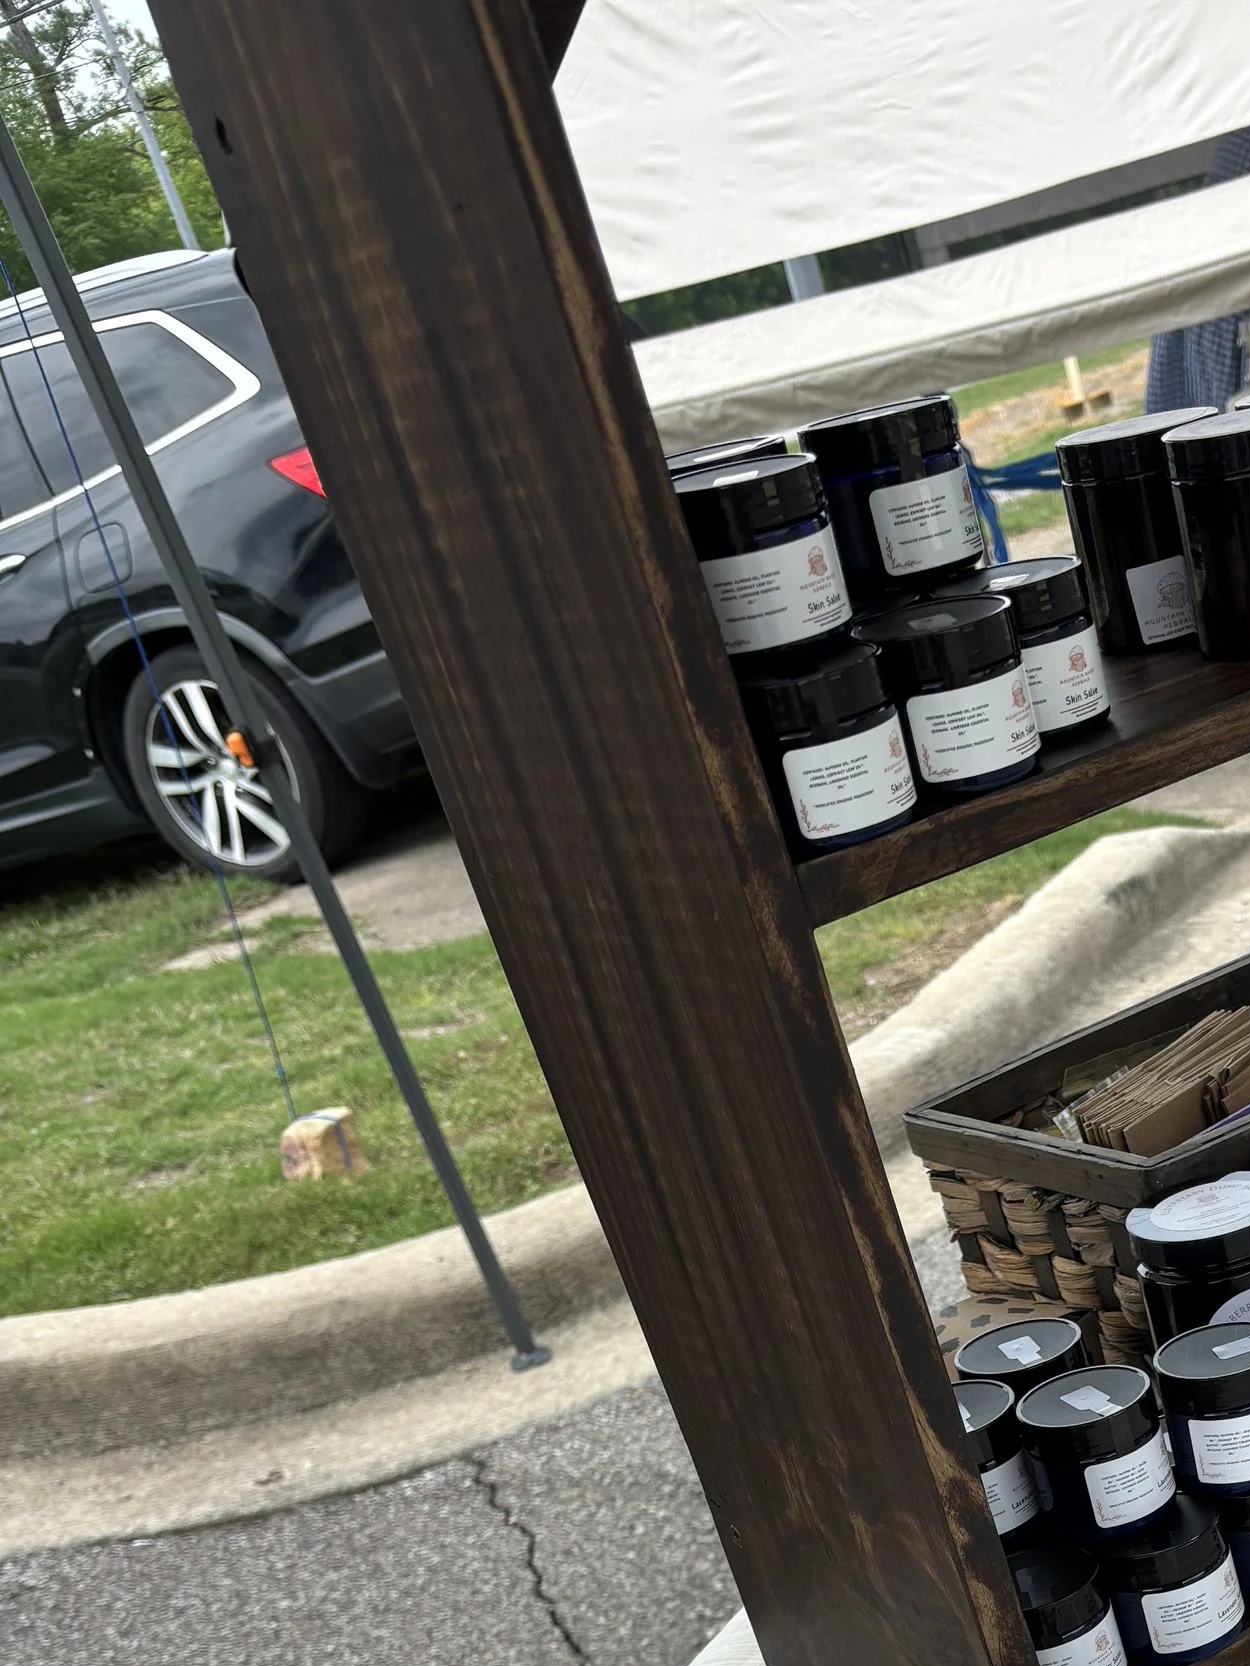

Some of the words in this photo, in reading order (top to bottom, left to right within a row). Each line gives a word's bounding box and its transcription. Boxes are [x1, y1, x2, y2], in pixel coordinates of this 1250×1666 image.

[808, 599, 825, 614] Skin
[826, 593, 841, 608] Salve
[1066, 694, 1082, 706] Skin
[1084, 687, 1099, 700] Salve
[1011, 729, 1024, 742] Skin
[891, 782, 903, 794] Skin
